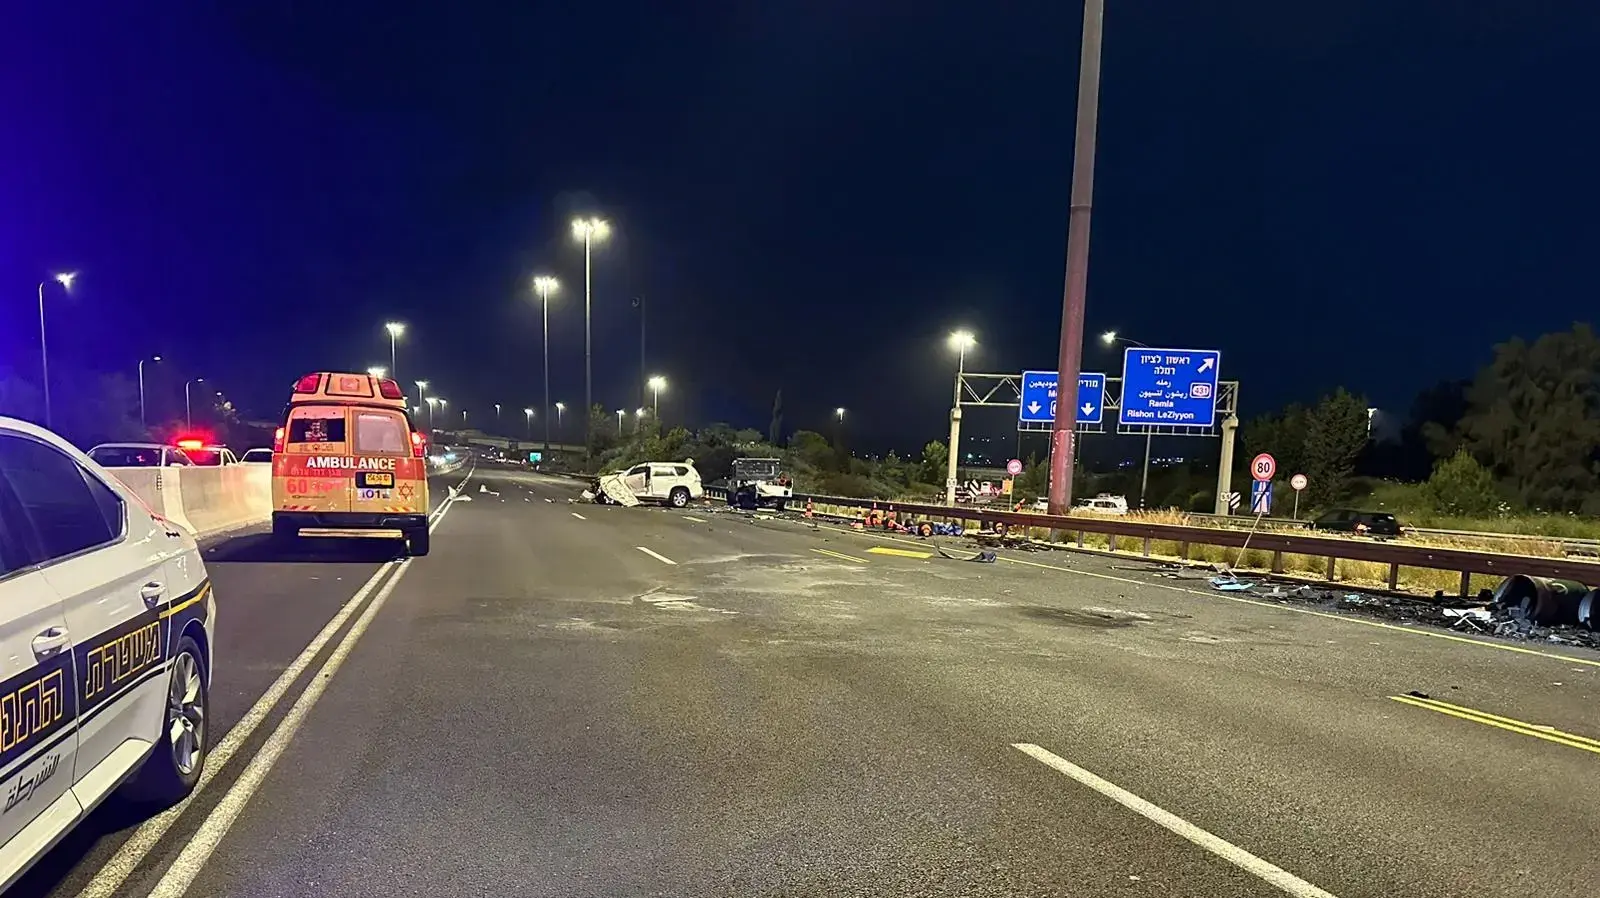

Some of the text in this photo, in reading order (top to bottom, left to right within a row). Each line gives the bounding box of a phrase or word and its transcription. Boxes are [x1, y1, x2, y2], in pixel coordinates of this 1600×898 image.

[1141, 355, 1190, 364] ראשון לציון
[1154, 366, 1176, 375] רמלה
[1194, 386, 1208, 394] 431
[1148, 400, 1174, 408] Ramla
[1127, 409, 1194, 421] Rishon LeZiyyon
[306, 456, 396, 470] AMBULANCE
[1257, 462, 1270, 473] 80
[287, 478, 308, 494] 60
[85, 620, 161, 700] משטרת
[0, 668, 63, 752] התנ
[3, 751, 61, 815] الشرطة
